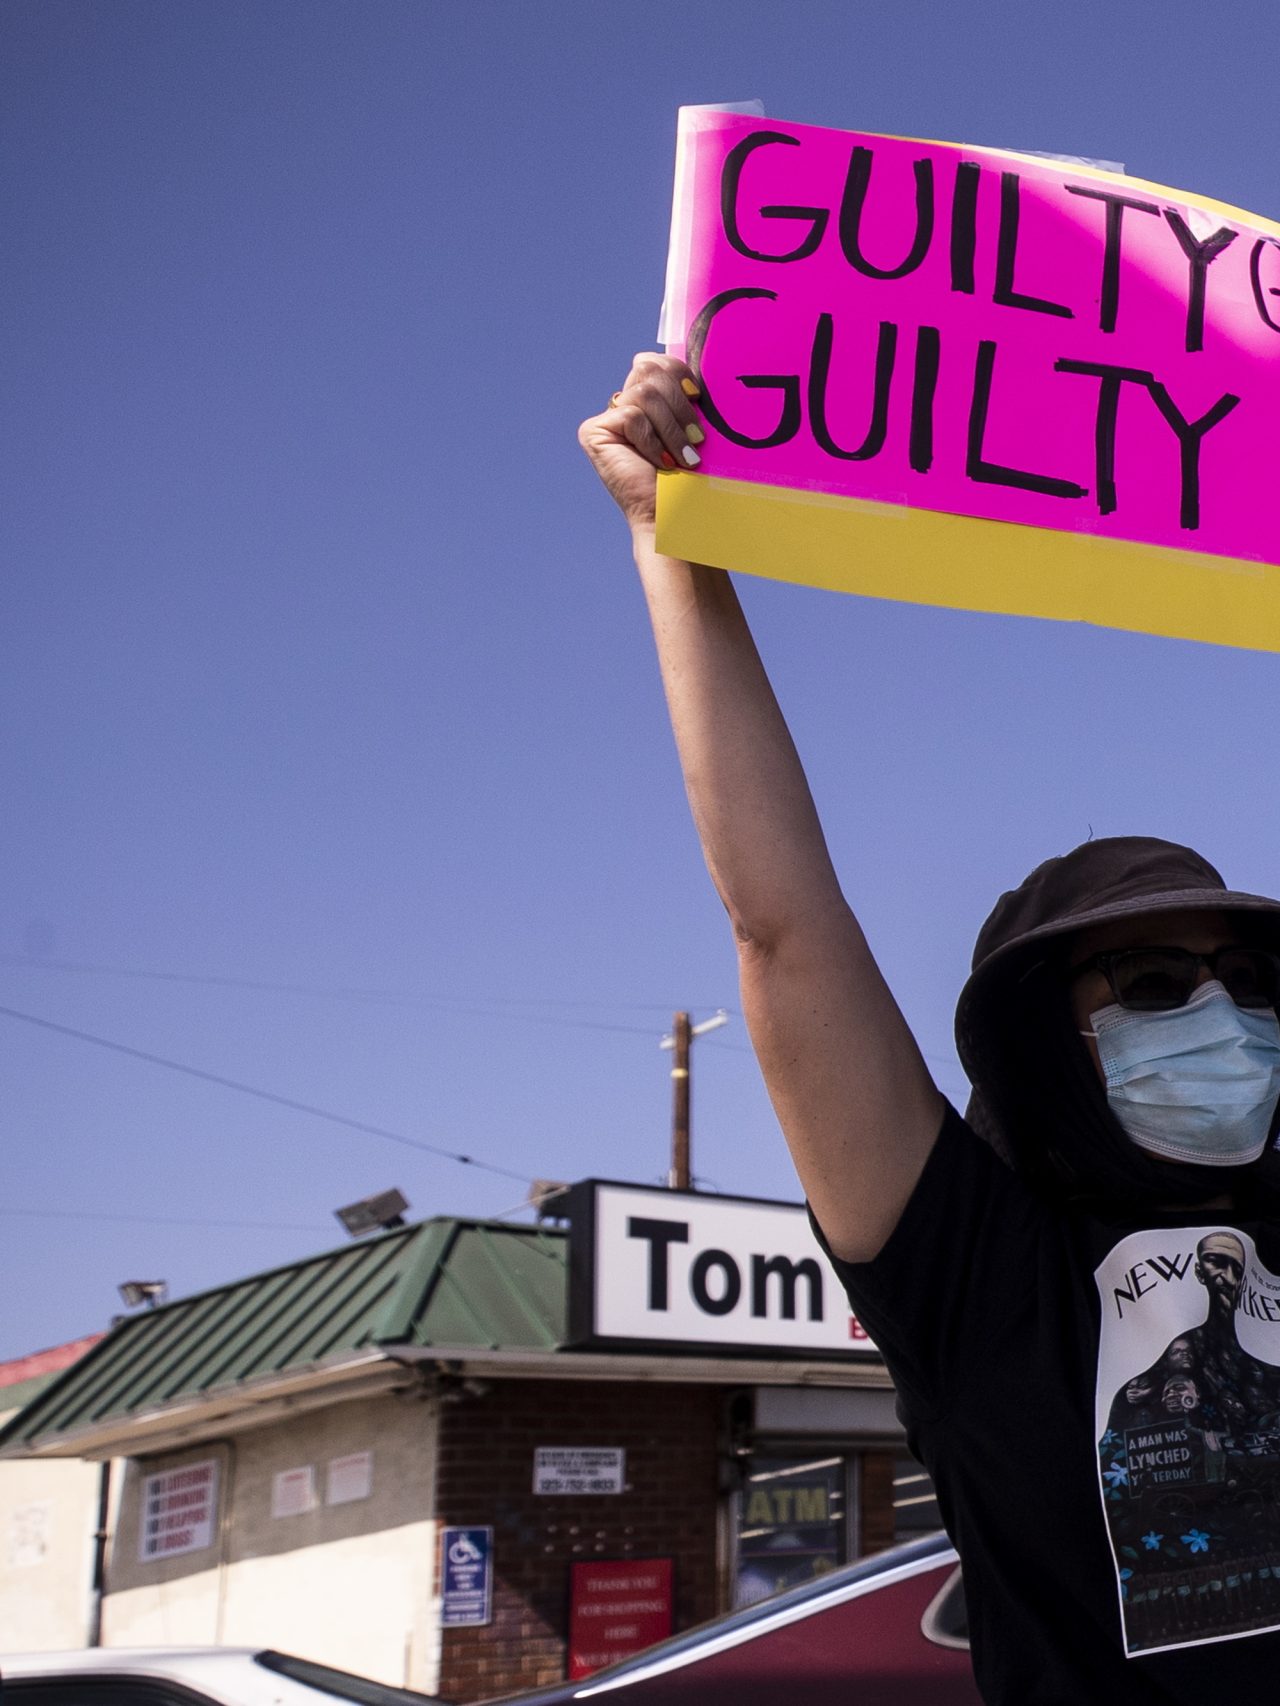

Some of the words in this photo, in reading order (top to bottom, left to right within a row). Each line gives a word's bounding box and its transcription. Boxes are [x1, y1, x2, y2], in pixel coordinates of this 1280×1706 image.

[720, 130, 1239, 353] GUILTY
[687, 286, 1241, 531] GUILTY
[1113, 1253, 1194, 1319] NEW
[1129, 1439, 1136, 1450] A
[1138, 1433, 1163, 1448] MAN
[1165, 1429, 1188, 1442] WAS
[1129, 1447, 1190, 1470] LYNCHED
[1131, 1467, 1191, 1486] YTERDAY
[747, 1487, 828, 1523] ATM
